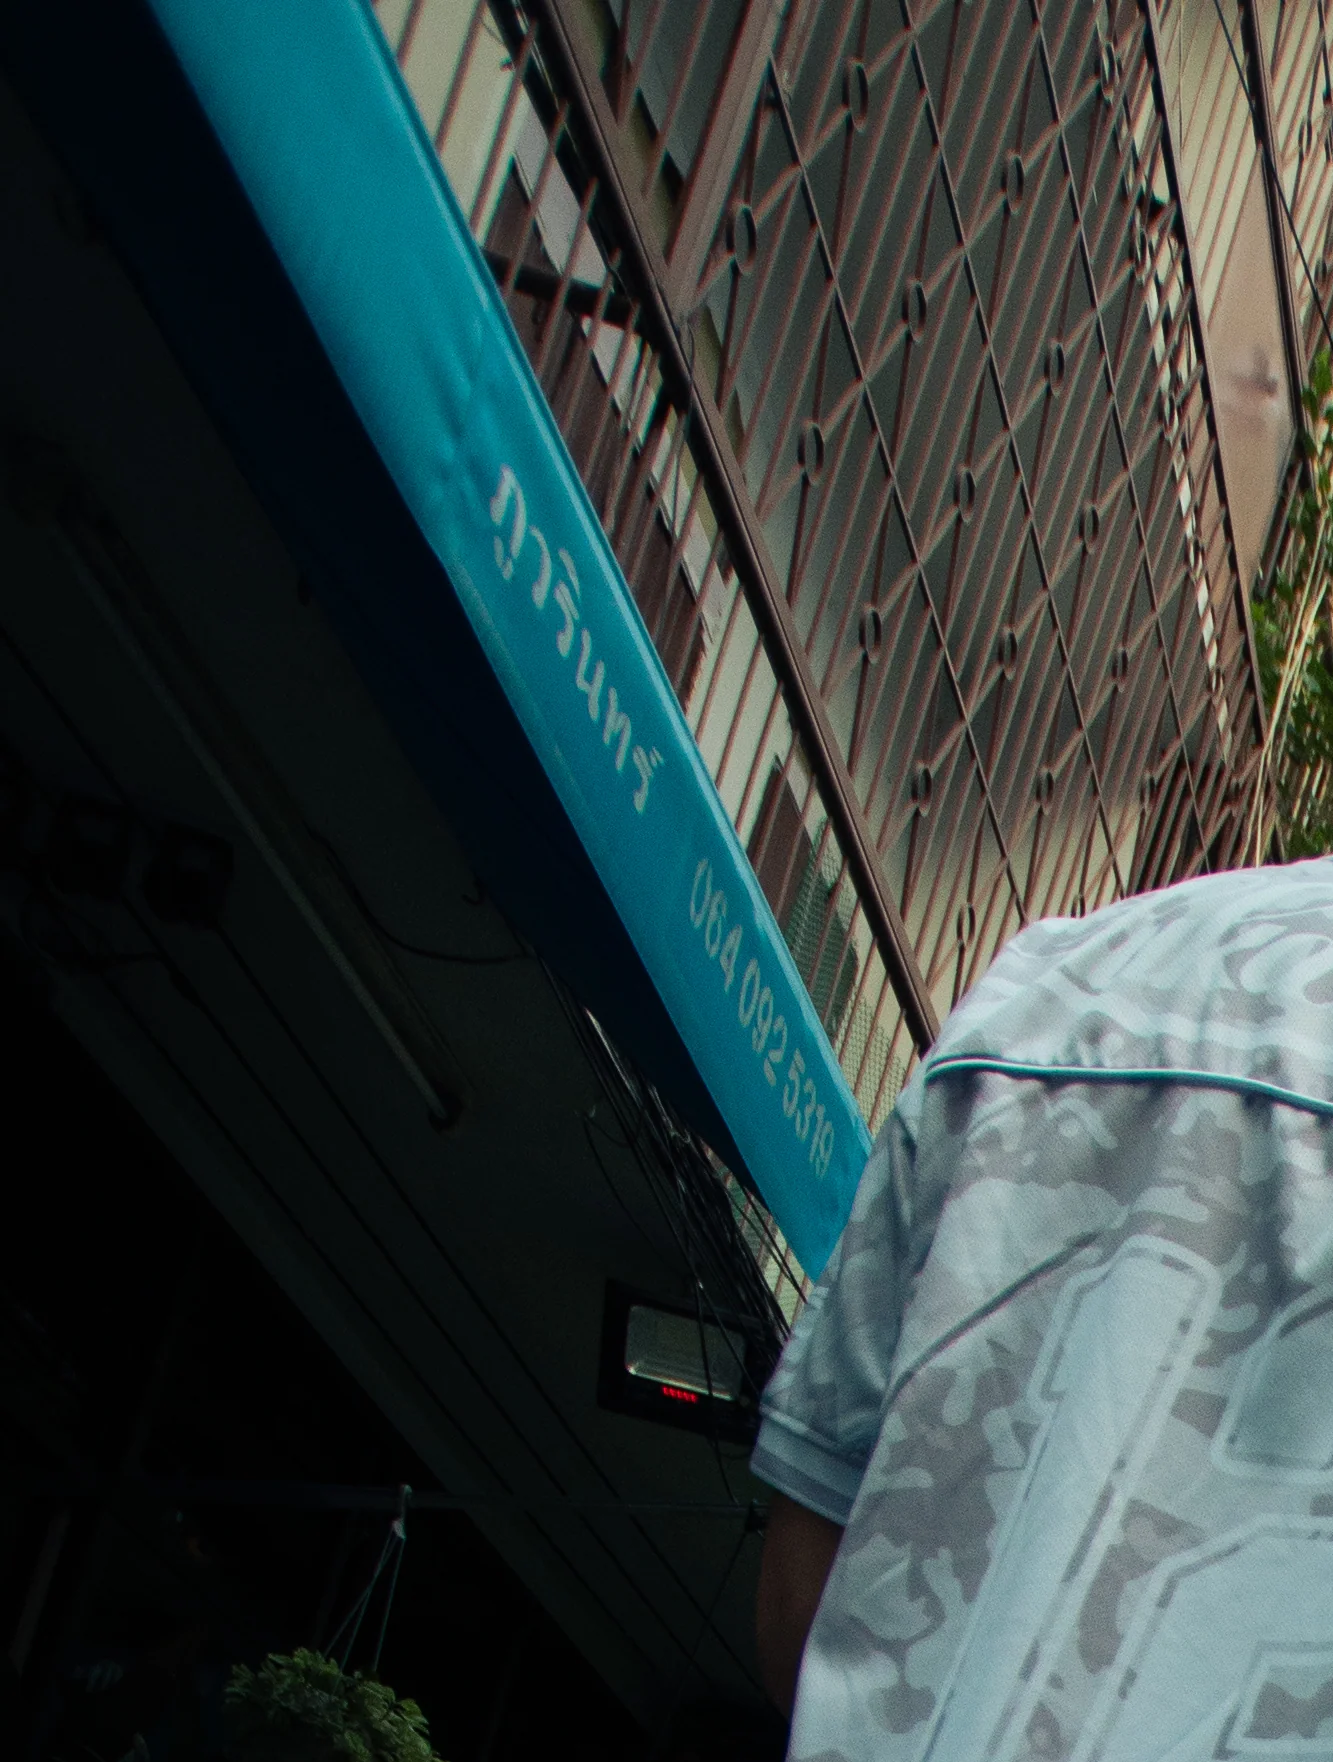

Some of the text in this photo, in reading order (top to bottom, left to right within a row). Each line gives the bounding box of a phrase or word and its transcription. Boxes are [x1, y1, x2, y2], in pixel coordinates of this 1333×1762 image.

[689, 858, 835, 1180] 064 092 5319
